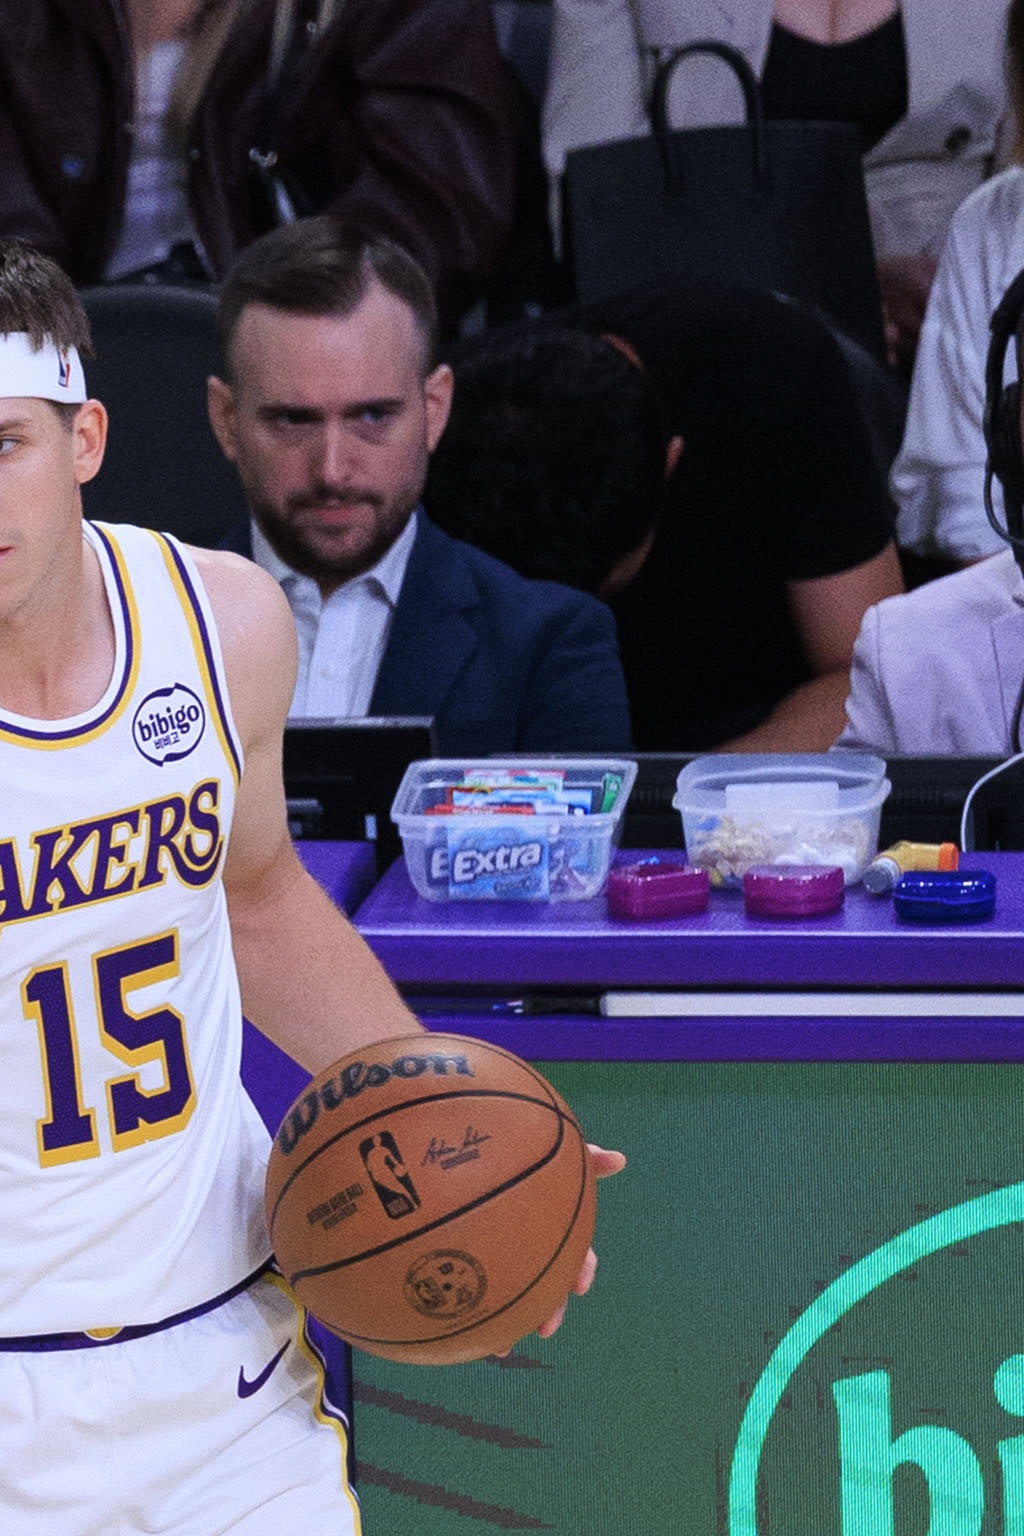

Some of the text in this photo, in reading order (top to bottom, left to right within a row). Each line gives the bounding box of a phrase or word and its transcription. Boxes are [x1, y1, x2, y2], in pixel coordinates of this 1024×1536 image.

[137, 704, 200, 742] bibigo
[453, 842, 542, 883] Extra
[21, 927, 198, 1168] 15
